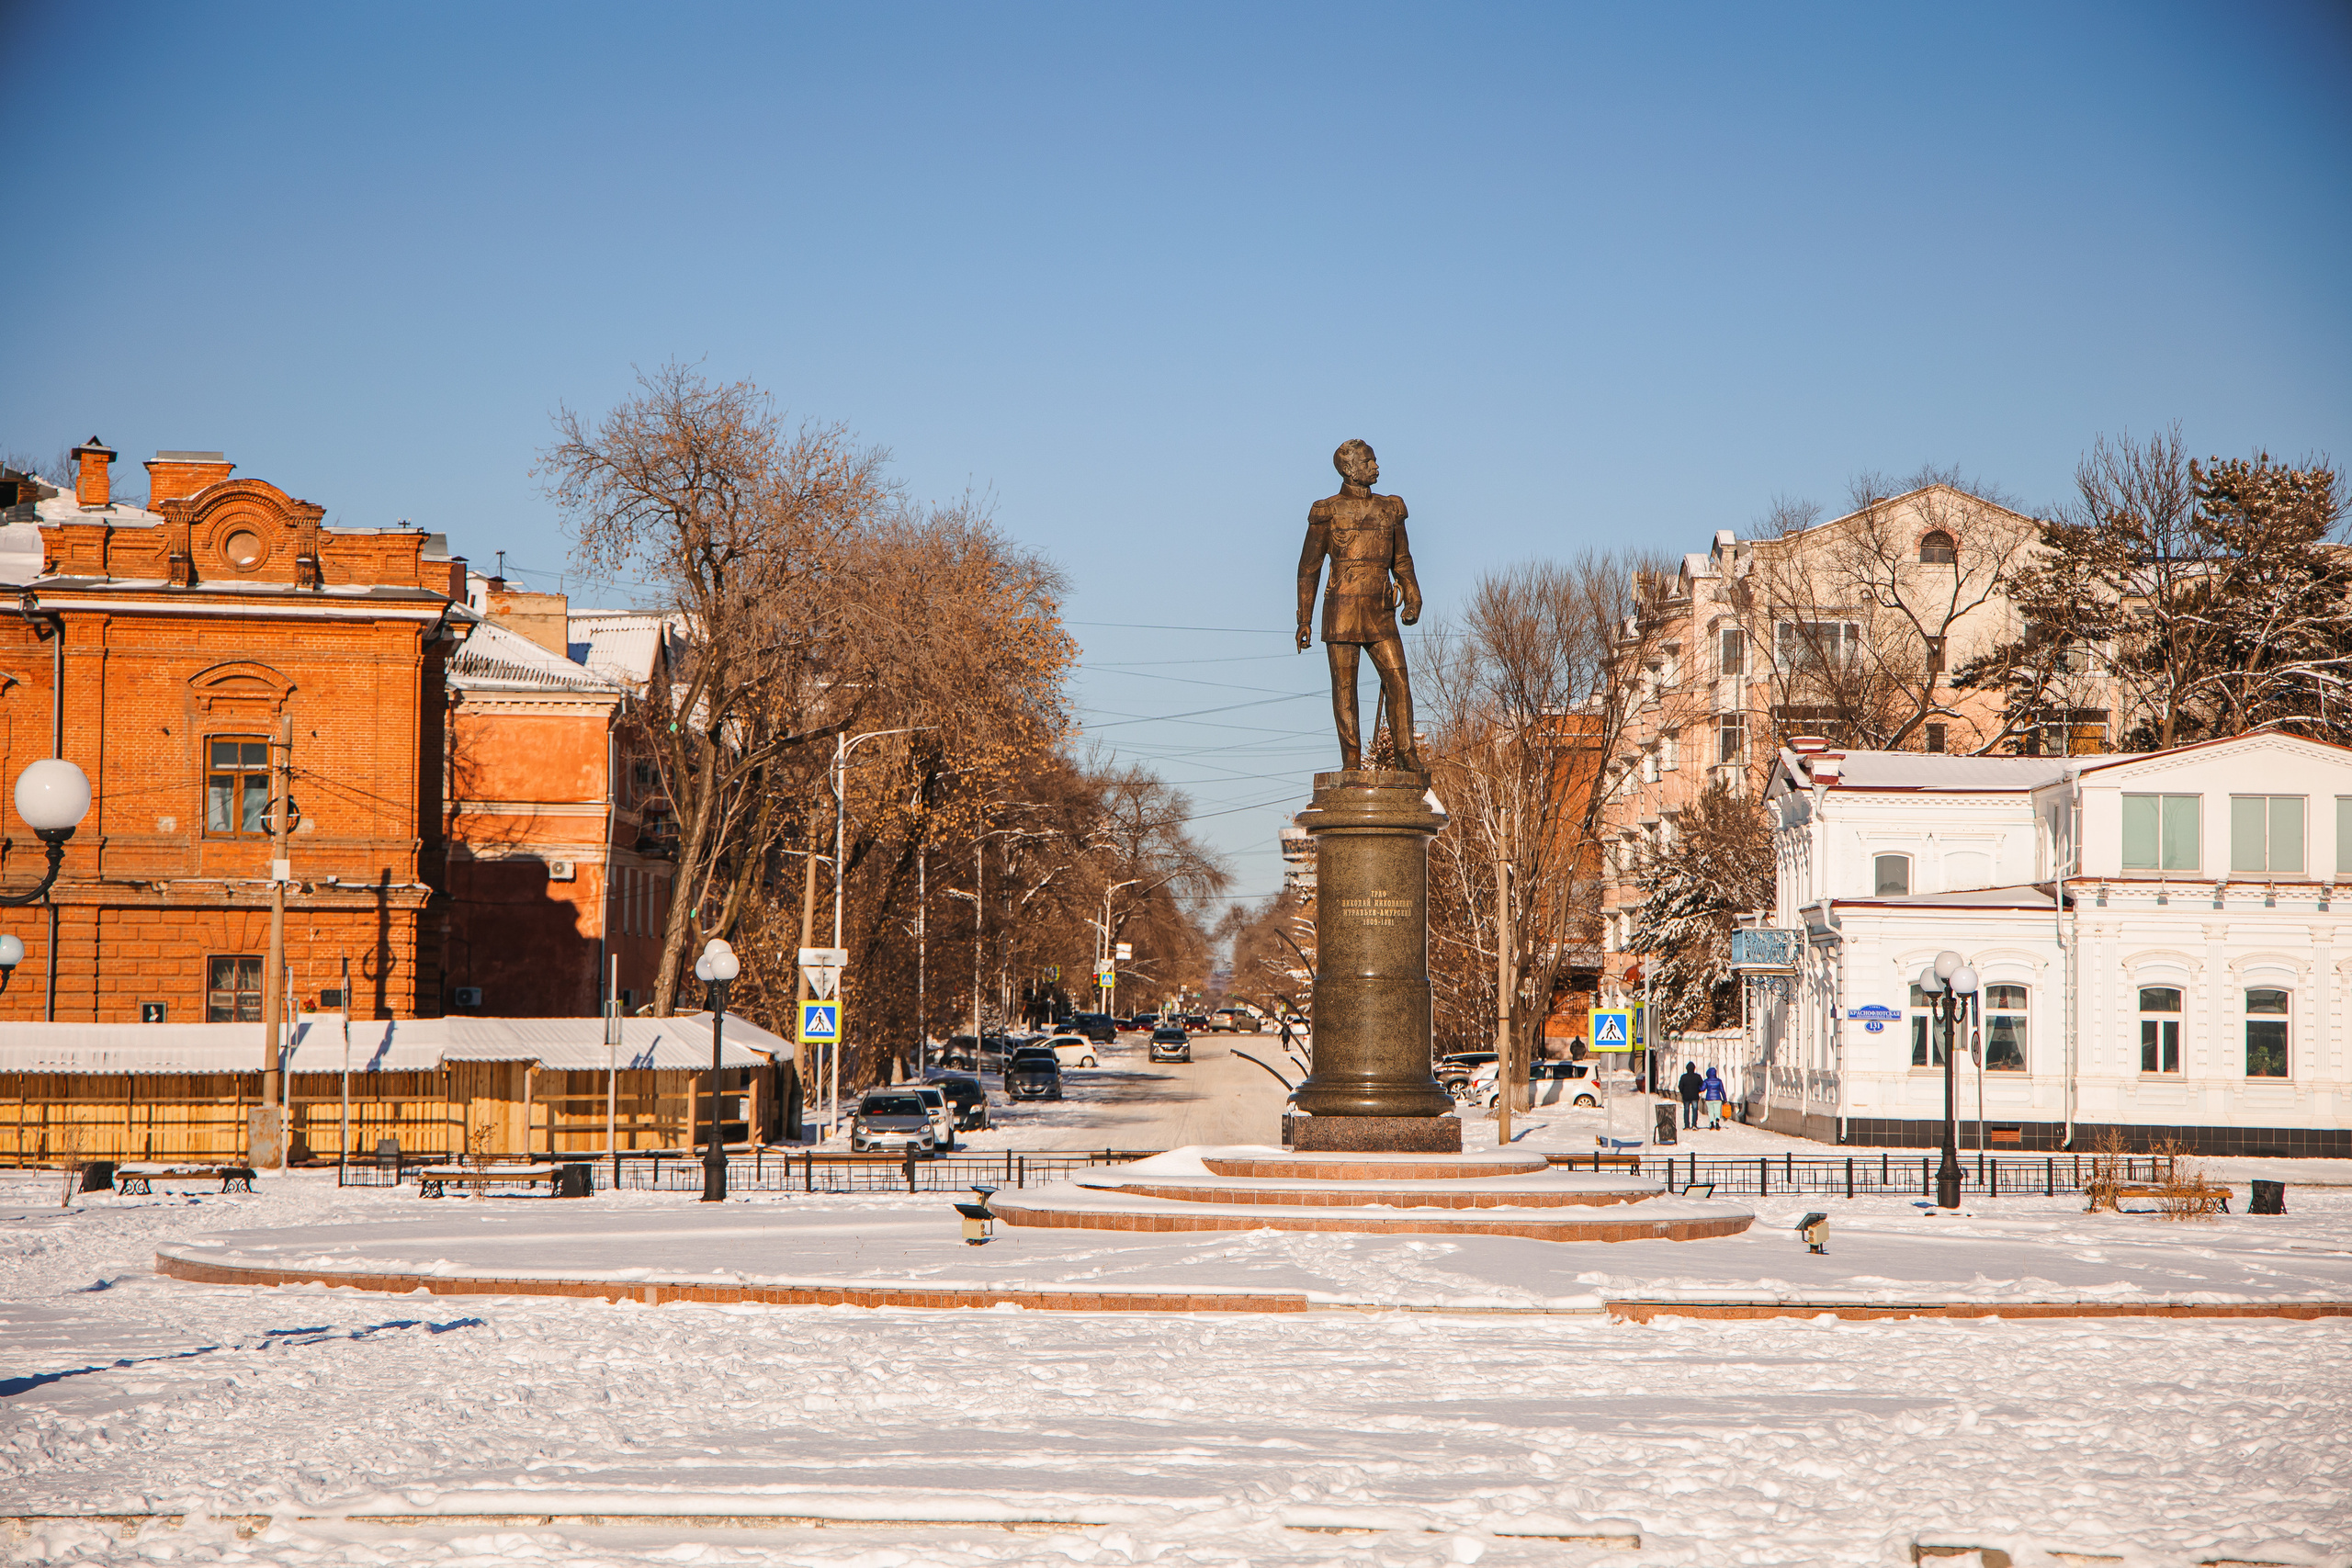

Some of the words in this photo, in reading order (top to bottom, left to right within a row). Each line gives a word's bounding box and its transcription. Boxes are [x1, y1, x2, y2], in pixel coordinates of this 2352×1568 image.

[1341, 897, 1371, 908] НИКОЛАЙ
[1374, 899, 1413, 908] НИКОЛАЕВИЧ
[1363, 918, 1395, 926] 1809-1881
